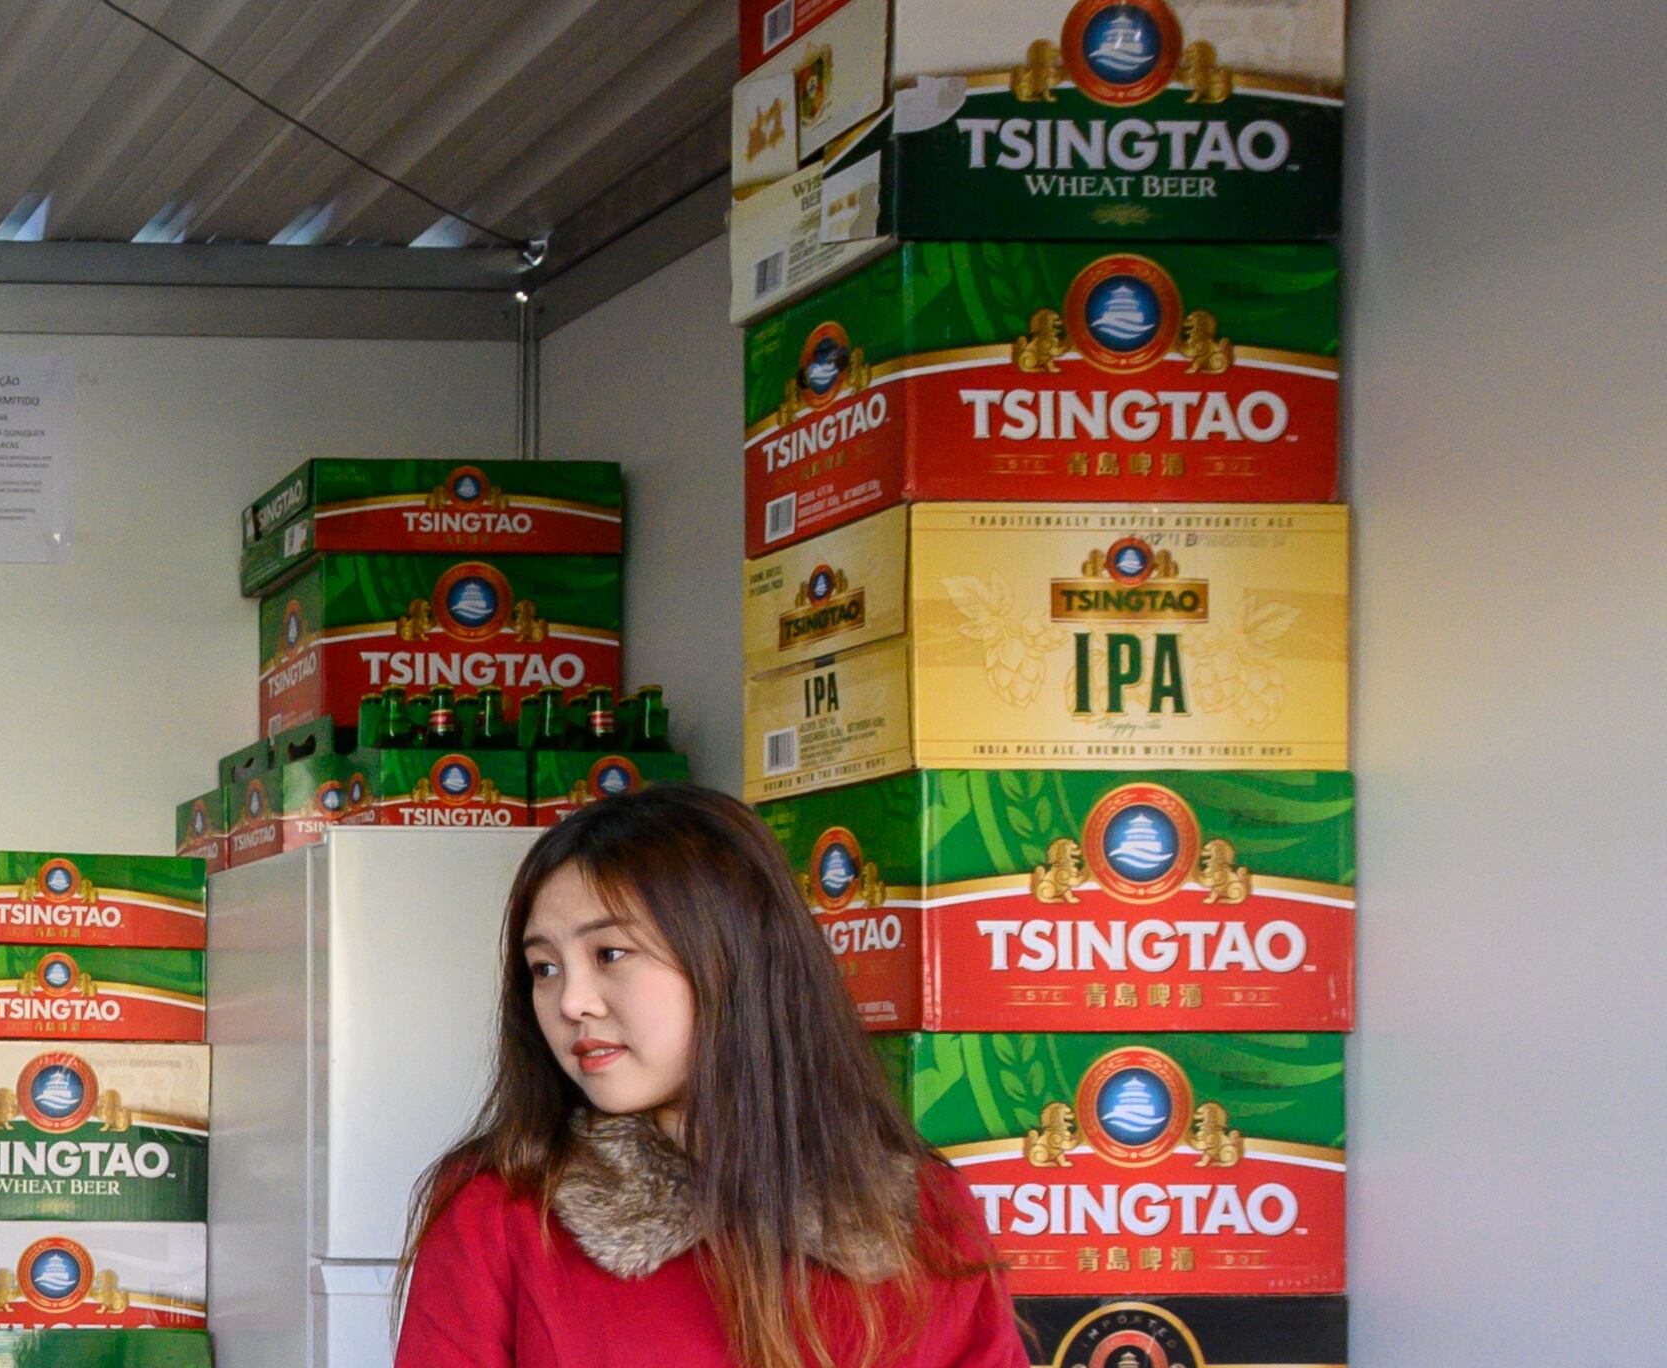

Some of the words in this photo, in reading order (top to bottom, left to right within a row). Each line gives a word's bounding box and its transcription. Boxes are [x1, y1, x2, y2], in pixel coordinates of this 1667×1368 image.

[957, 117, 1291, 171] TSINGTAO
[1024, 173, 1133, 197] WHEAT
[1141, 173, 1218, 197] BEER
[761, 391, 889, 474] TSINGTAO
[960, 389, 1290, 444] TSINGTAO
[403, 511, 532, 534] TSINGTAO
[970, 515, 1090, 529] TRADITIONALLY
[1100, 516, 1166, 529] CRAFTED
[1175, 516, 1259, 529] AUTHENTIC
[1267, 516, 1294, 529] ALE
[781, 599, 862, 638] TSINGTAO
[1060, 588, 1200, 613] TSINGTAO
[268, 652, 317, 698] TSINGTAO
[360, 652, 584, 687] TSINGTAO
[1073, 633, 1190, 716] IPA
[804, 671, 839, 718] IPA
[973, 745, 1009, 756] INDIA
[1017, 745, 1047, 756] PALE
[1086, 746, 1137, 756] BREWED
[1144, 746, 1174, 756] WITH
[1181, 746, 1202, 756] THE
[1209, 746, 1252, 757] FINEST
[1260, 746, 1293, 757] HOPS
[399, 808, 512, 826] TSINGTAO
[976, 919, 1307, 974] TSINGTAO
[1084, 983, 1204, 1010] 青島啤酒
[70, 1179, 120, 1196] BEER
[970, 1183, 1298, 1236] TSINGTAO
